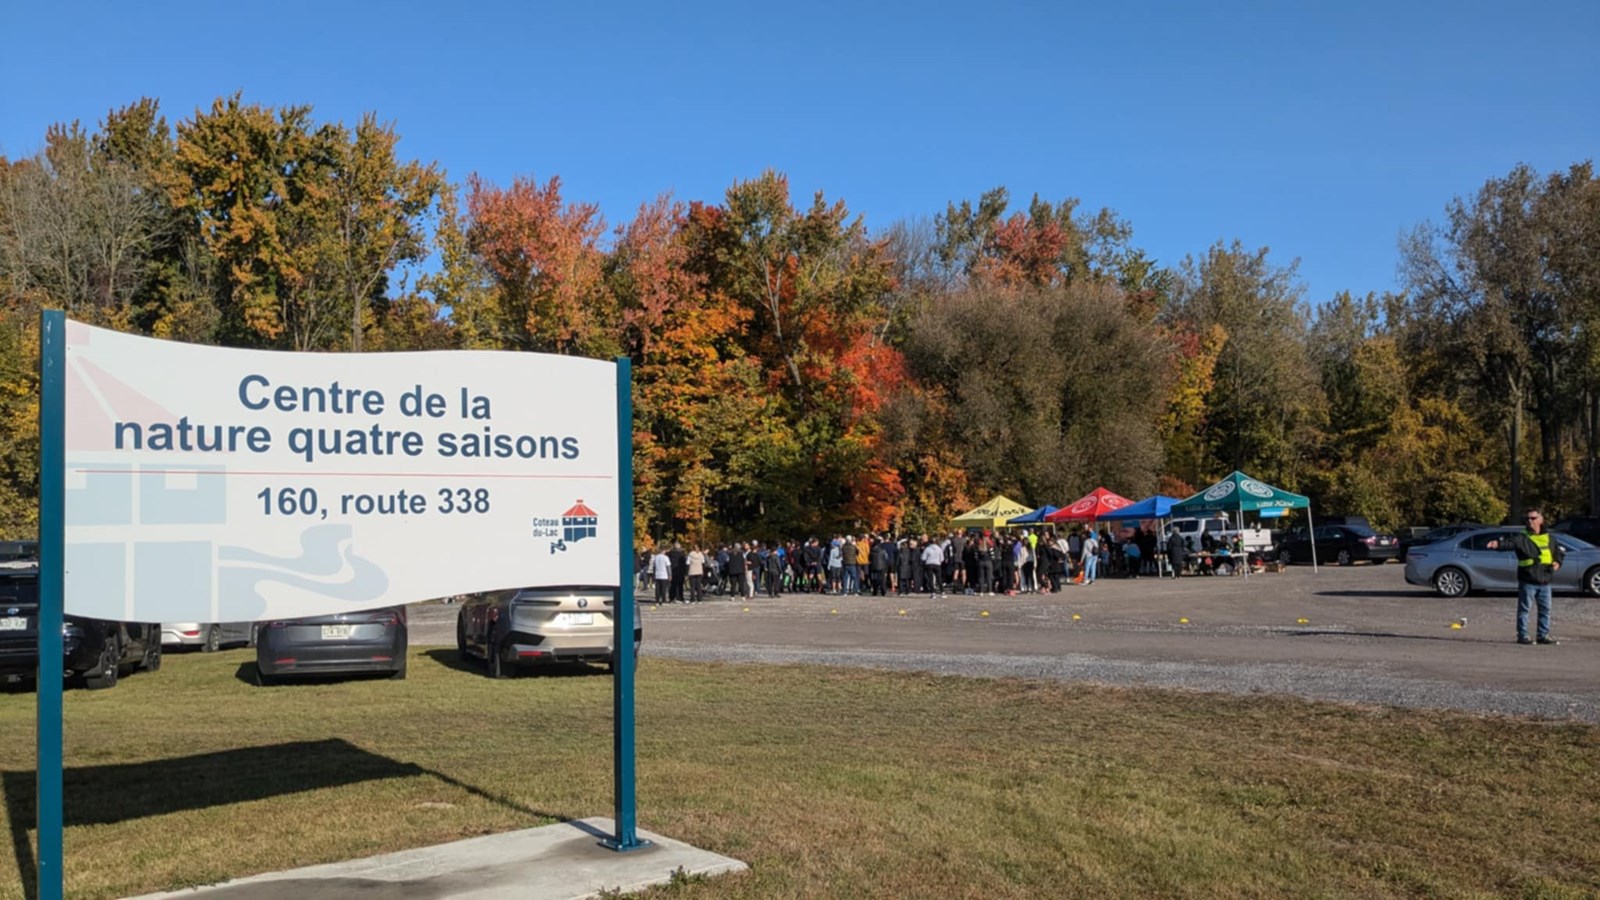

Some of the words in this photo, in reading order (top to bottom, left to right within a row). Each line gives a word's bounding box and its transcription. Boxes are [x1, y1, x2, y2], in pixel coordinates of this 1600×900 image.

[238, 374, 386, 416] Centre
[399, 384, 448, 418] de
[461, 387, 491, 420] la
[114, 416, 272, 453] nature
[288, 423, 424, 463] quatre
[437, 426, 580, 460] saisons
[256, 487, 328, 520] 160,
[341, 489, 427, 515] route
[438, 488, 491, 515] 338
[533, 517, 559, 526] Coteau
[533, 528, 558, 537] du-Lac
